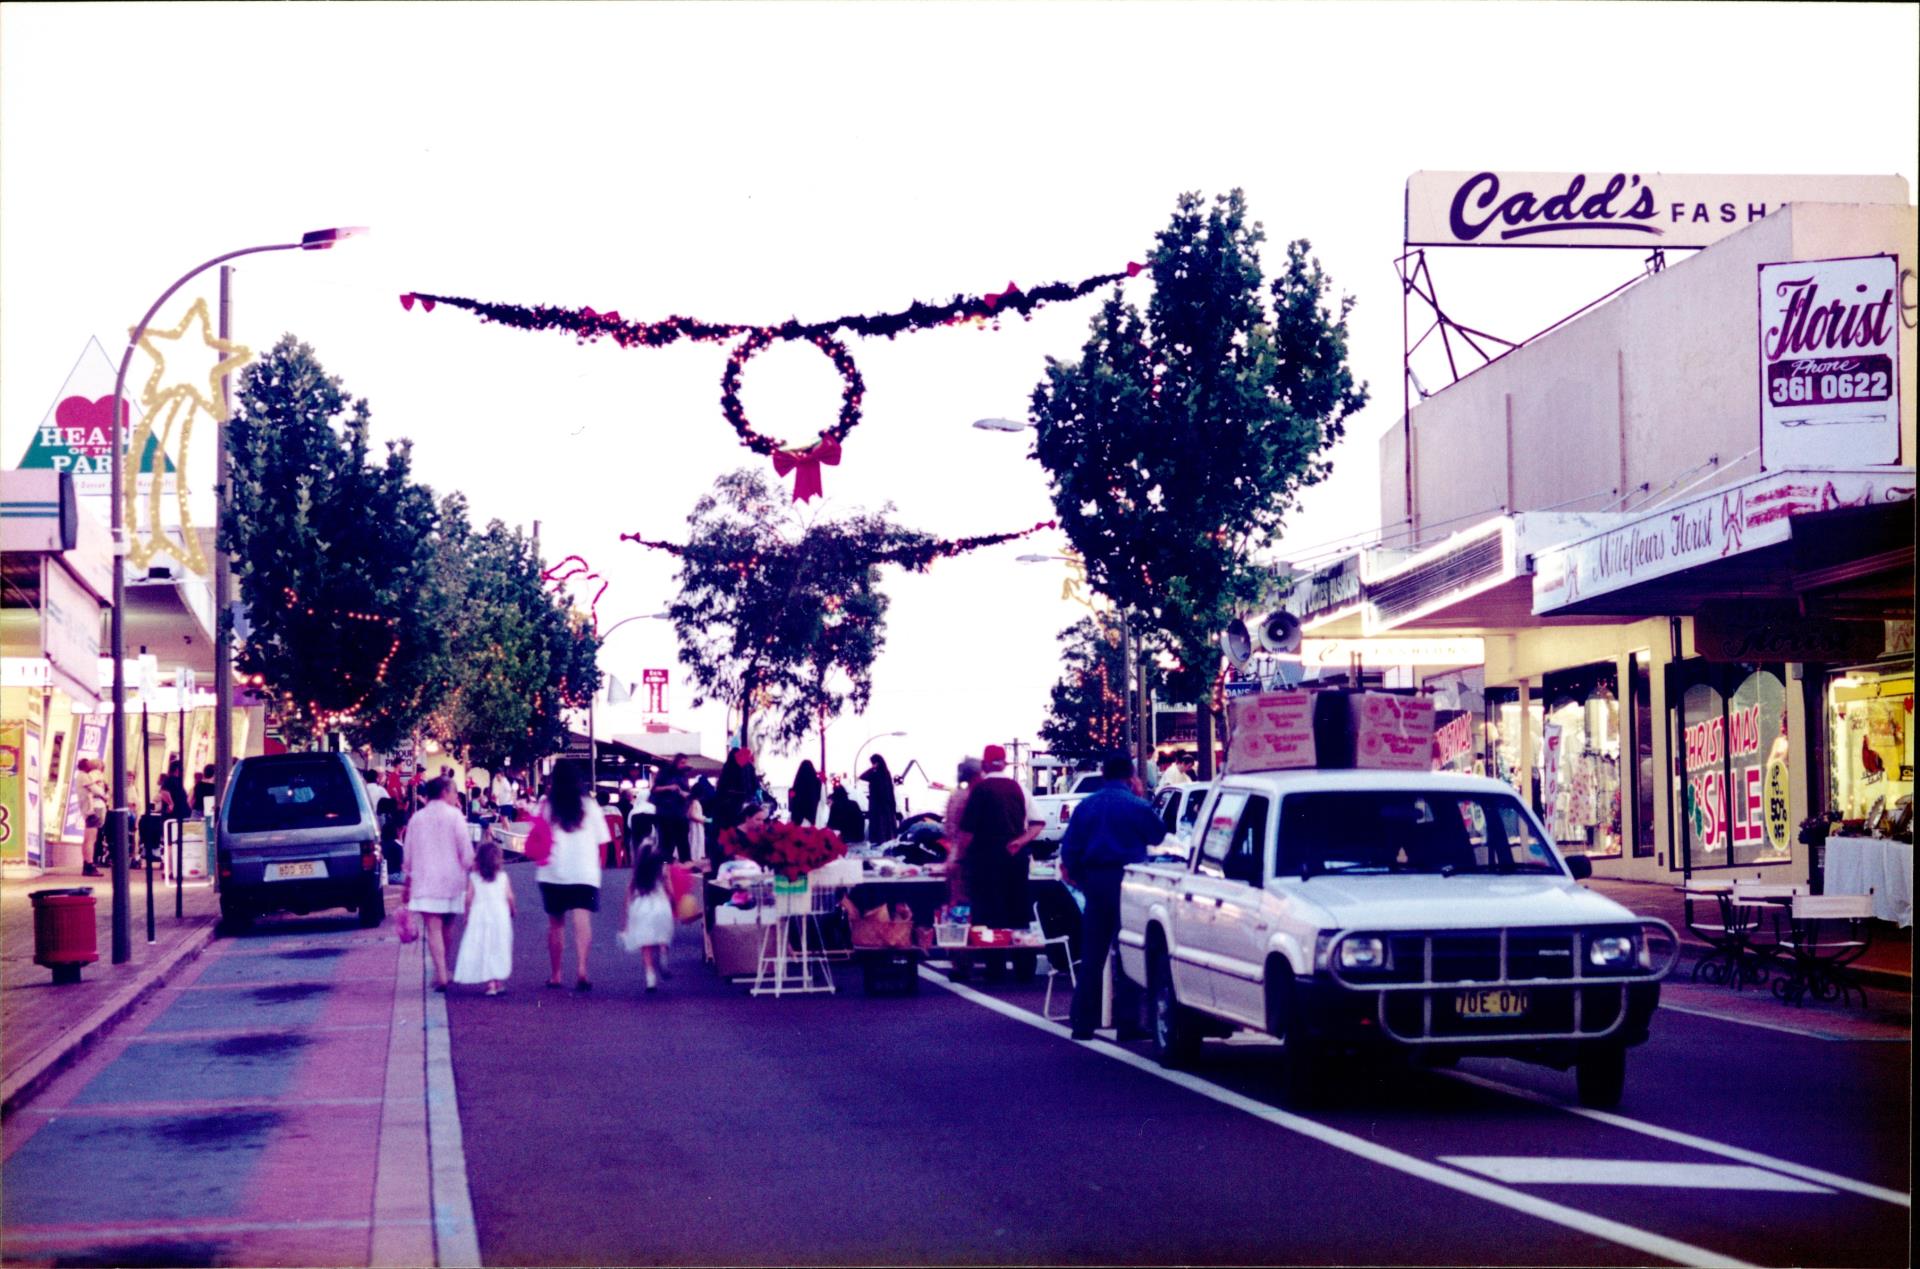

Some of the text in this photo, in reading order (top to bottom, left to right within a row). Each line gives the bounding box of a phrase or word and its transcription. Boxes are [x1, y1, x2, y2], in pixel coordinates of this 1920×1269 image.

[1450, 172, 1790, 240] Cadd's FASH
[1765, 276, 1893, 361] Florist
[1773, 372, 1887, 402] 361 0622
[1791, 359, 1860, 377] Phone
[40, 427, 141, 446] HEAR
[51, 456, 127, 473] PAR
[1671, 507, 1712, 556] Florist
[1704, 766, 1763, 850] SALE
